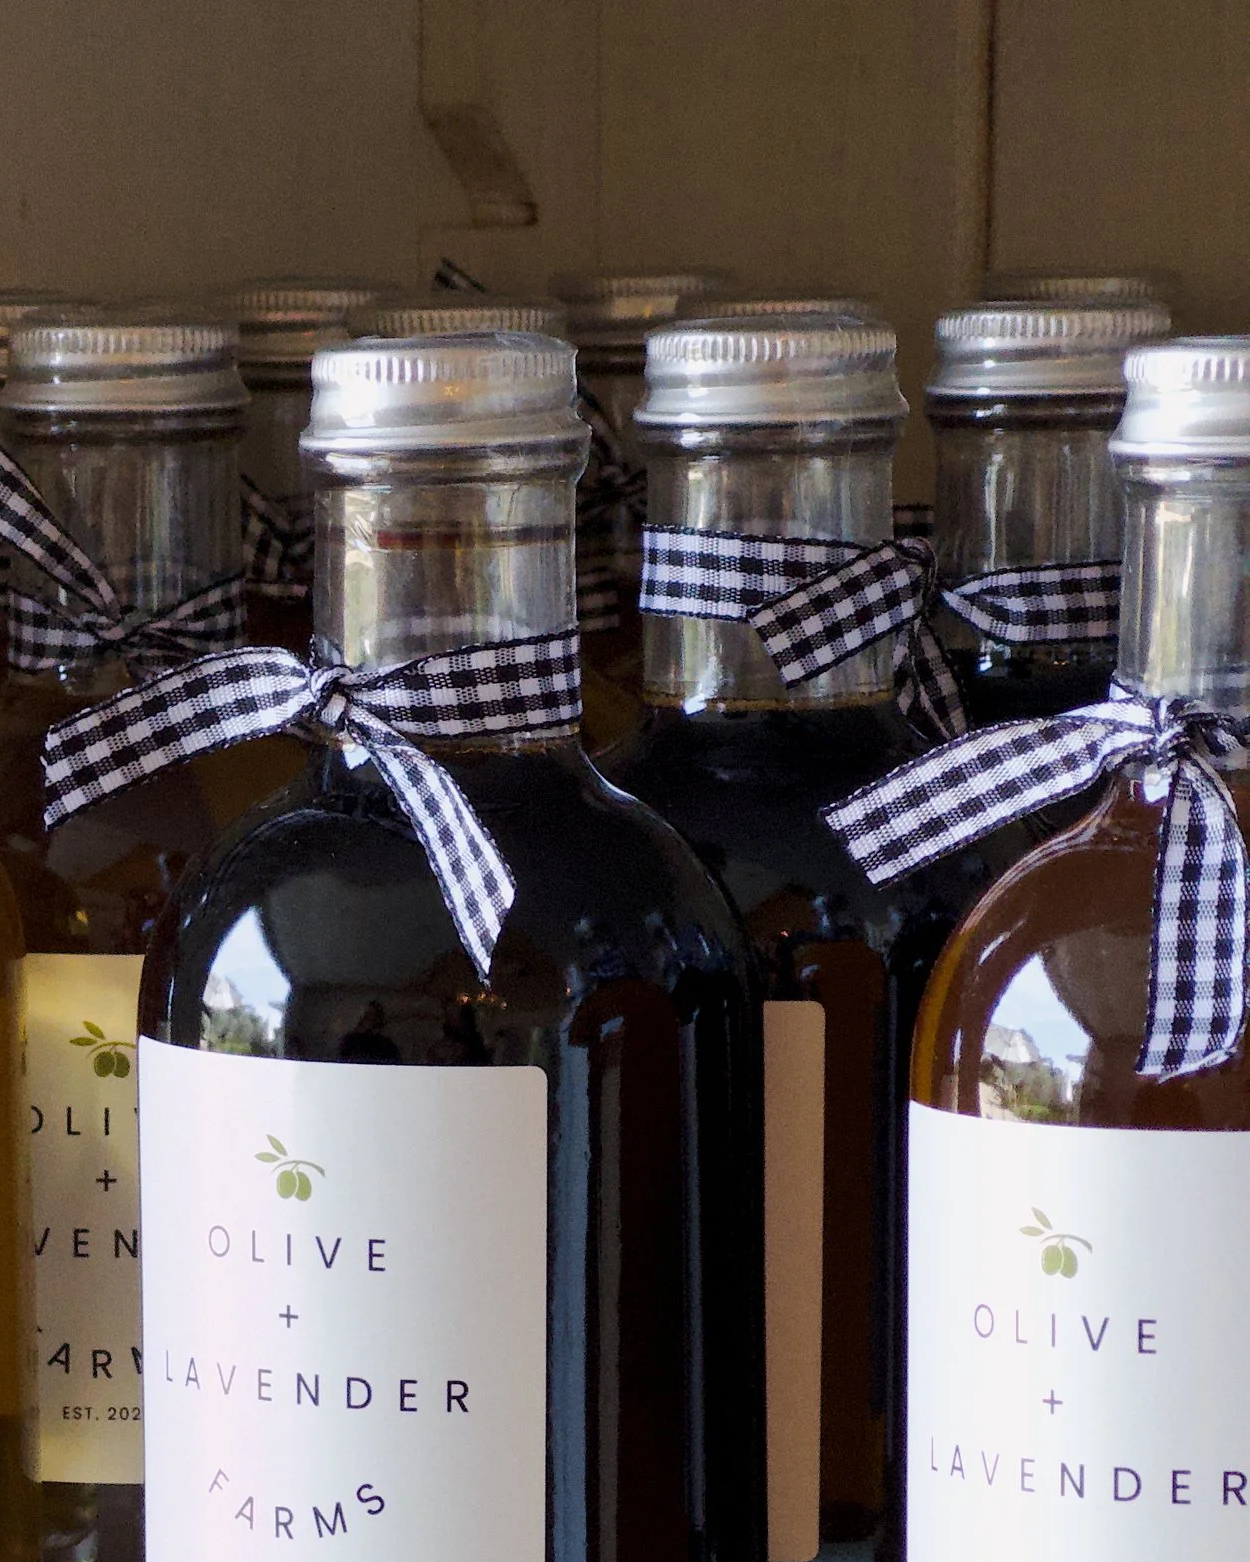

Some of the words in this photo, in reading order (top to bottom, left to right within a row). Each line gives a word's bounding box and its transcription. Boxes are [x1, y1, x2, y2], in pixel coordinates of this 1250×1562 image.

[96, 1170, 117, 1191] +
[209, 1225, 386, 1273] OLIVE
[278, 1304, 299, 1329] +
[973, 1303, 1158, 1355] OLIVE
[165, 1348, 470, 1413] LAVENDER
[1042, 1388, 1064, 1415] +
[63, 1406, 99, 1420] EST.
[108, 1407, 141, 1420] 202
[930, 1436, 1248, 1506] LAVENDER
[209, 1469, 386, 1540] FARMS
